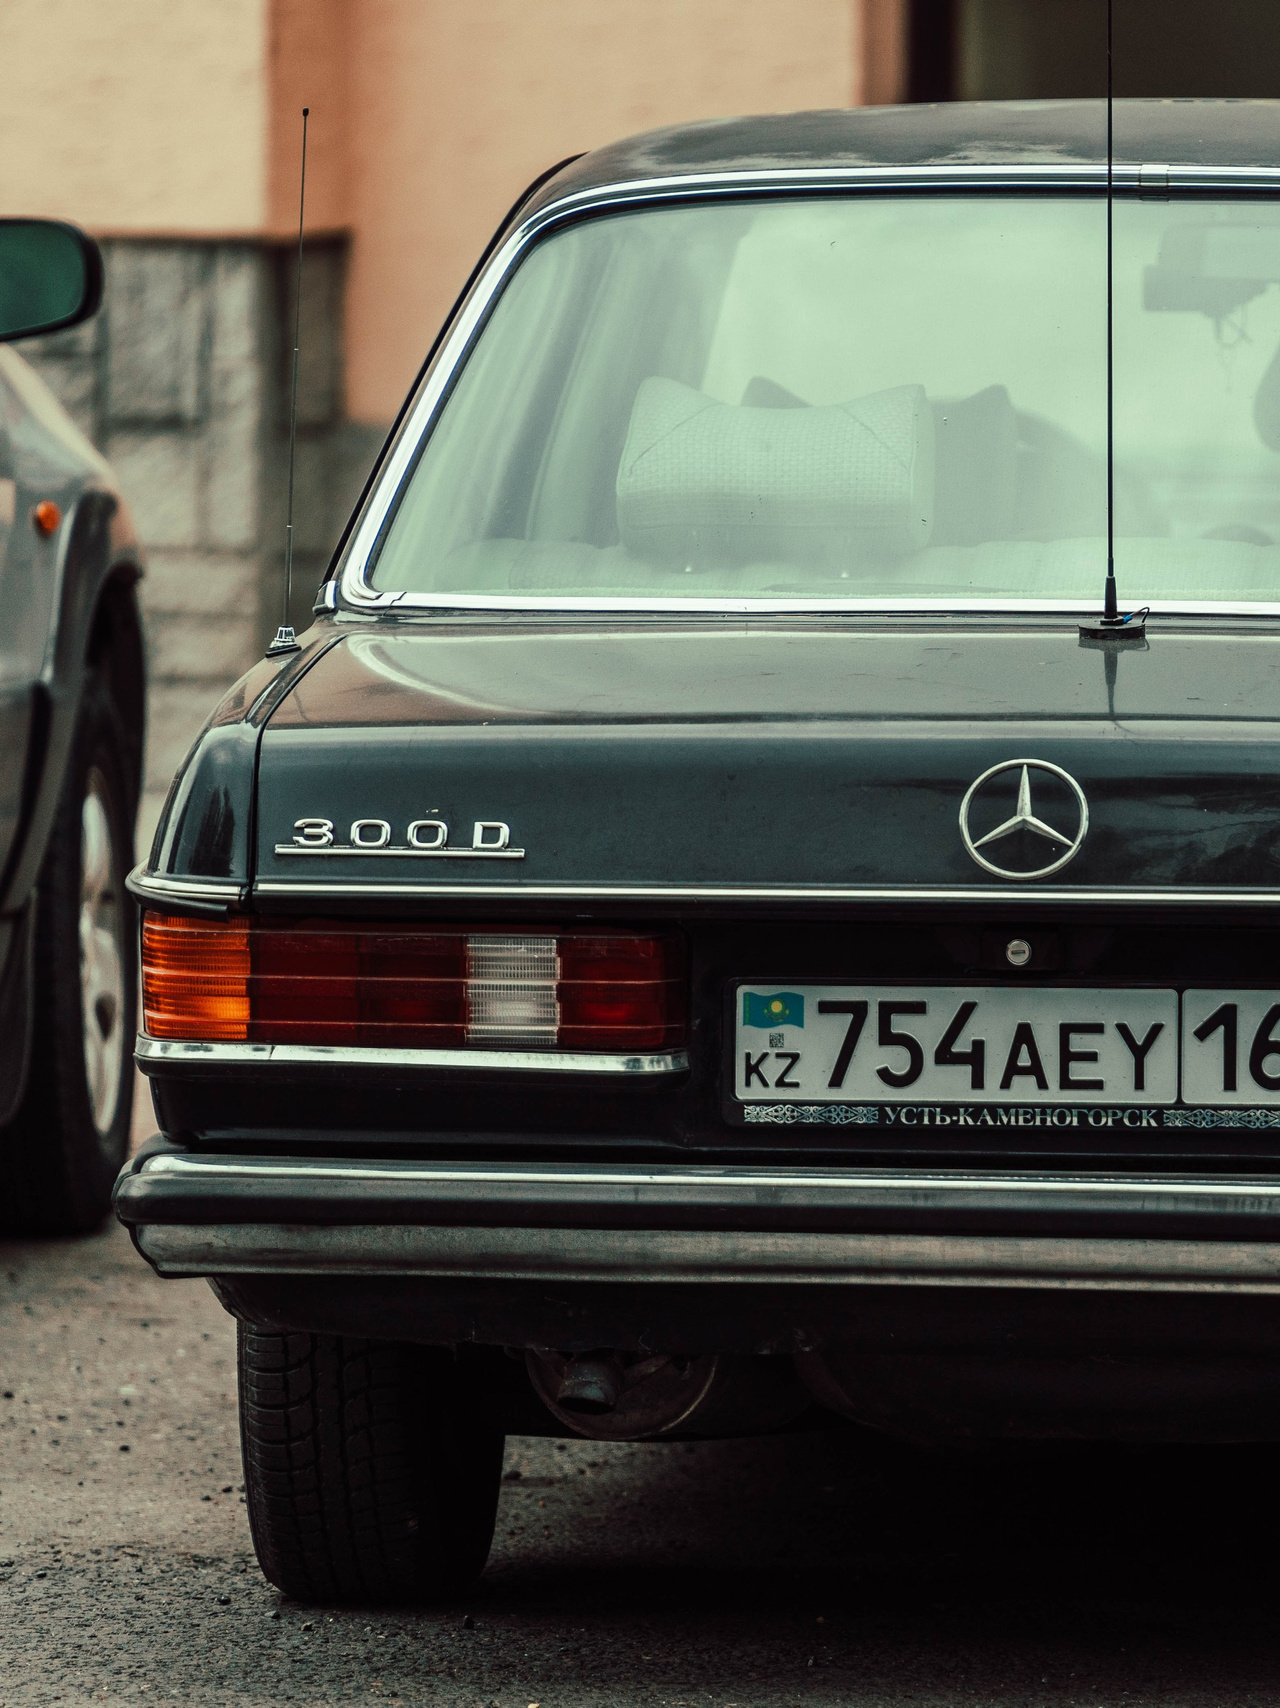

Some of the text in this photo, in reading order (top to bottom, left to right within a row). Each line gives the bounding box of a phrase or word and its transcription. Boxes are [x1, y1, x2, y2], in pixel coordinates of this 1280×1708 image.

[292, 818, 511, 849] 300 D
[744, 1051, 801, 1089] KZ
[817, 1000, 1165, 1091] 754AEY
[884, 1106, 1159, 1128] УСТЬ-КАМЕНОГОРСК
